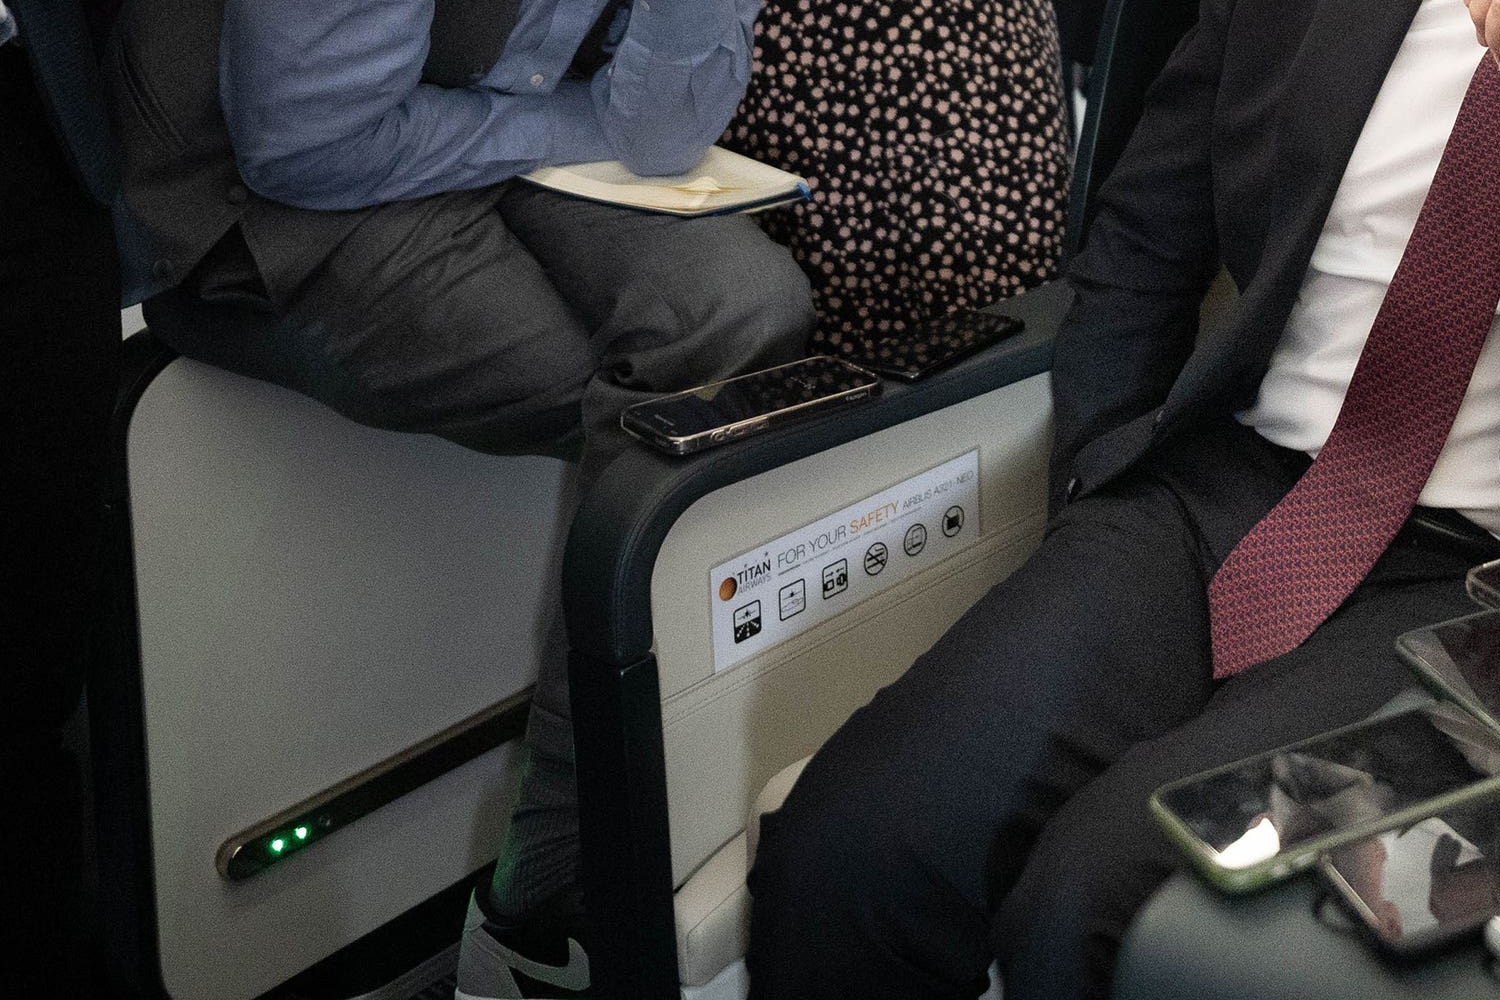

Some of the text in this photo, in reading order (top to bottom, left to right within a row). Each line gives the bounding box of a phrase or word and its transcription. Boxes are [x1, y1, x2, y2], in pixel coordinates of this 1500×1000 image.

[777, 544, 806, 568] FOR
[808, 525, 847, 552] YOUR
[849, 499, 900, 534] SAFETY
[902, 488, 932, 510] AIRBUS
[736, 558, 771, 585] TITAN
[738, 574, 772, 595] AIRWAYS
